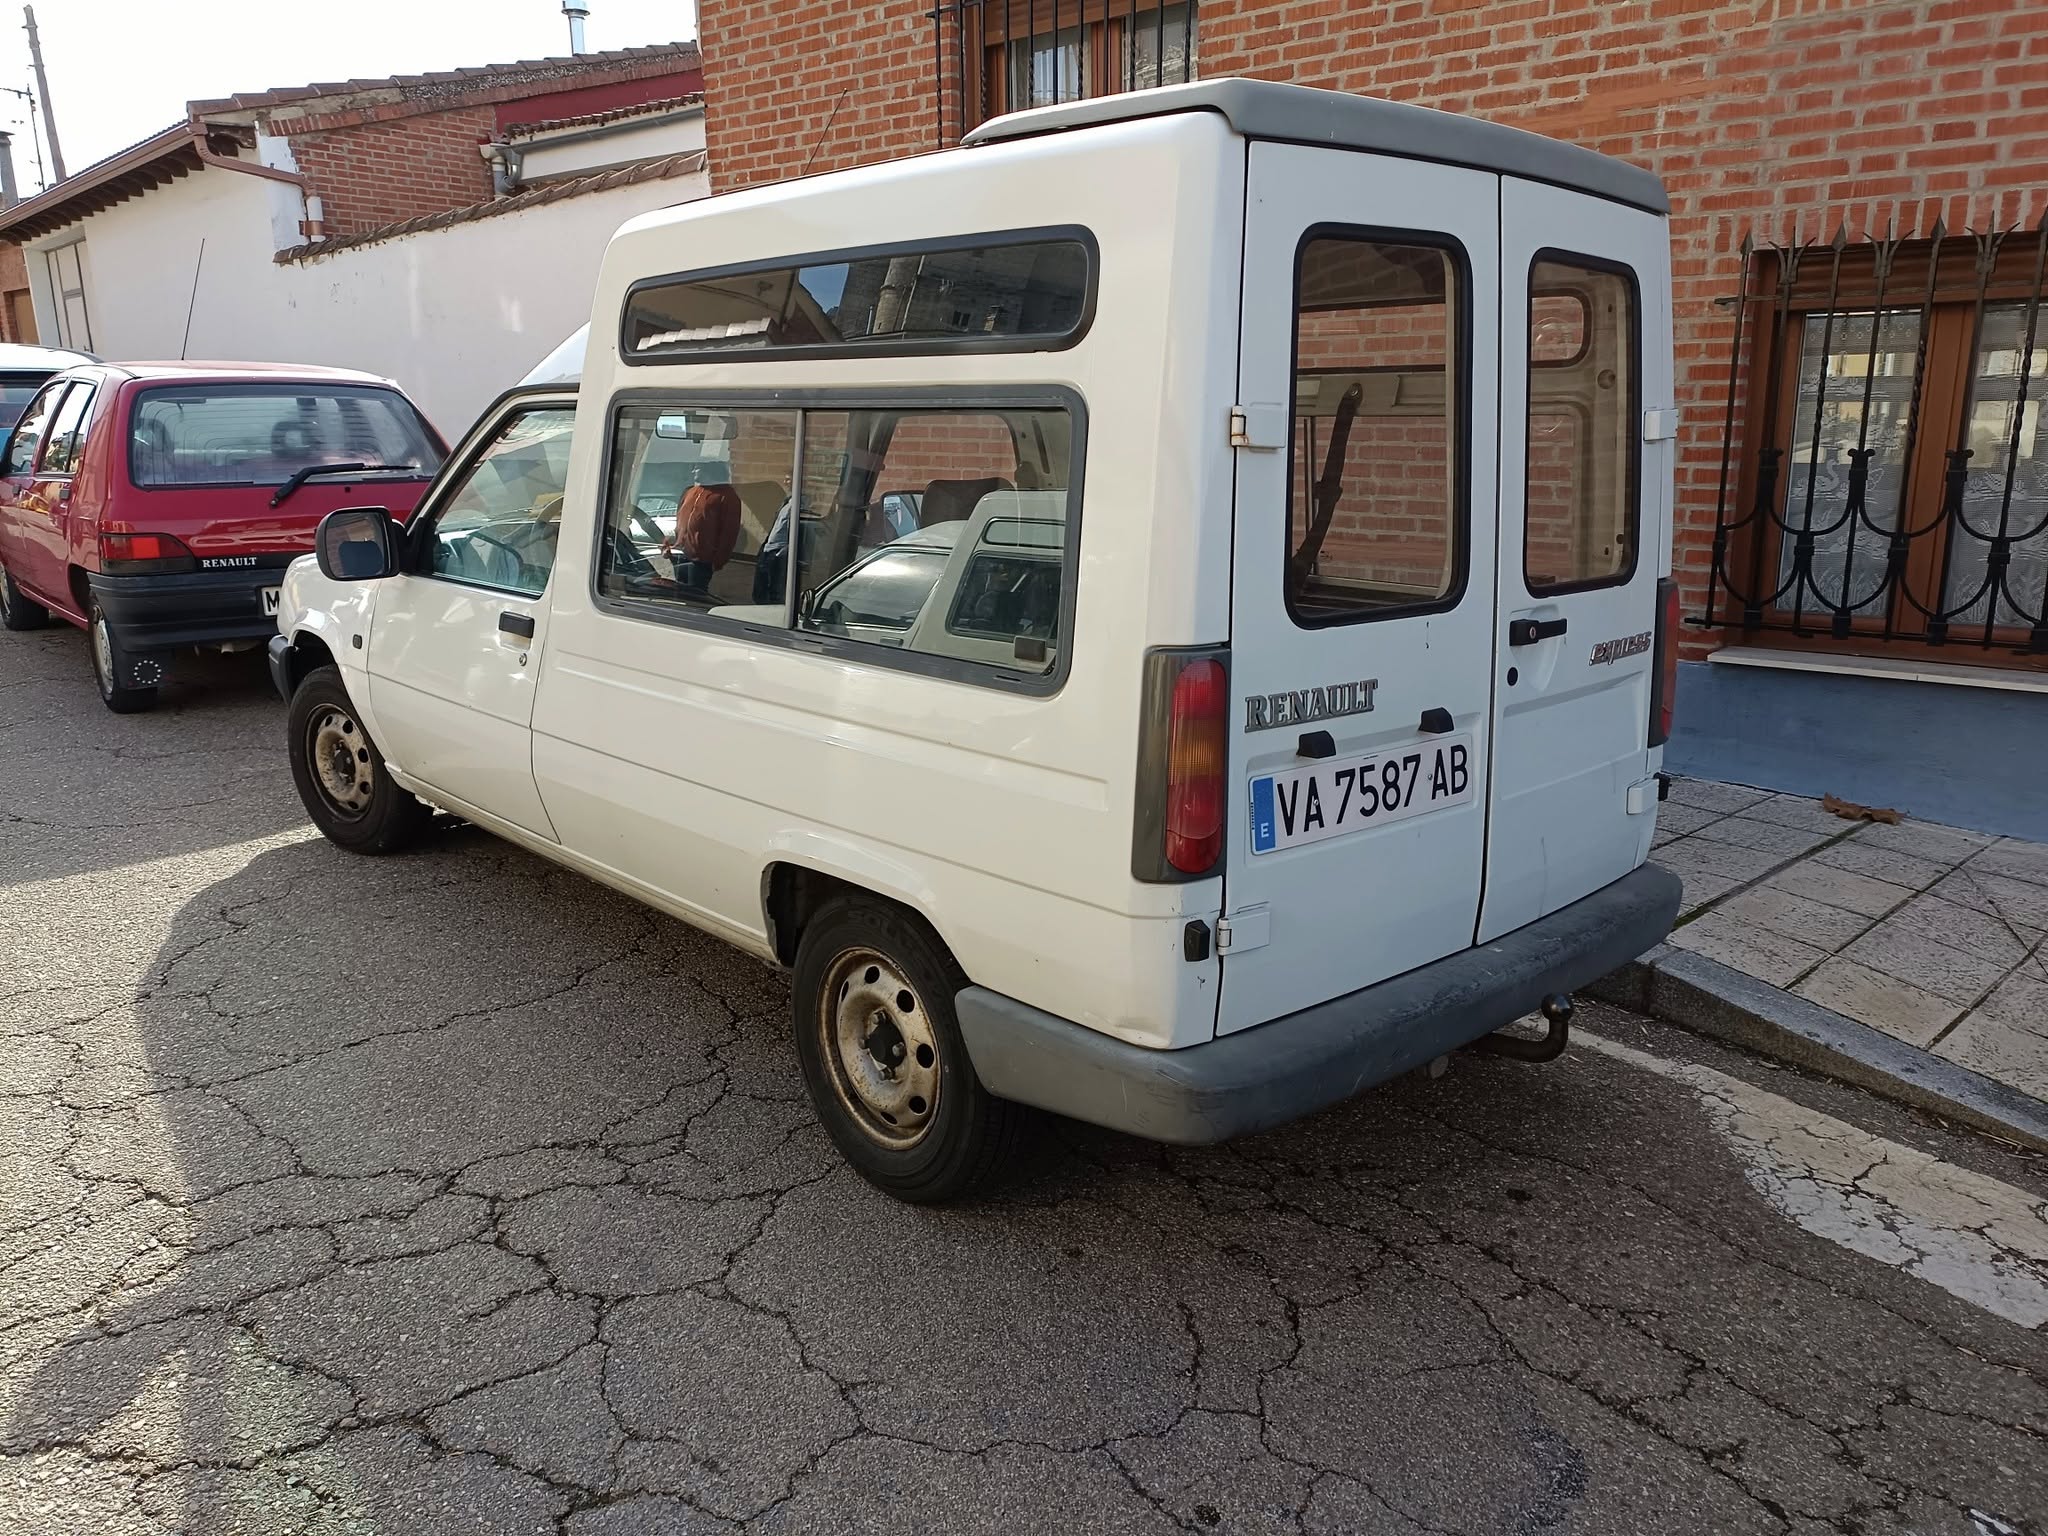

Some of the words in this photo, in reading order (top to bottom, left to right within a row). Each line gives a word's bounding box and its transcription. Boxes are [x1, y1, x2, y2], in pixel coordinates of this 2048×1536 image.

[203, 558, 257, 568] RENAULT
[265, 590, 280, 612] M
[1245, 679, 1378, 732] RENAULT
[1277, 777, 1325, 836] VA
[1335, 753, 1422, 825] 7587
[1431, 744, 1468, 800] AB
[1260, 822, 1270, 839] E
